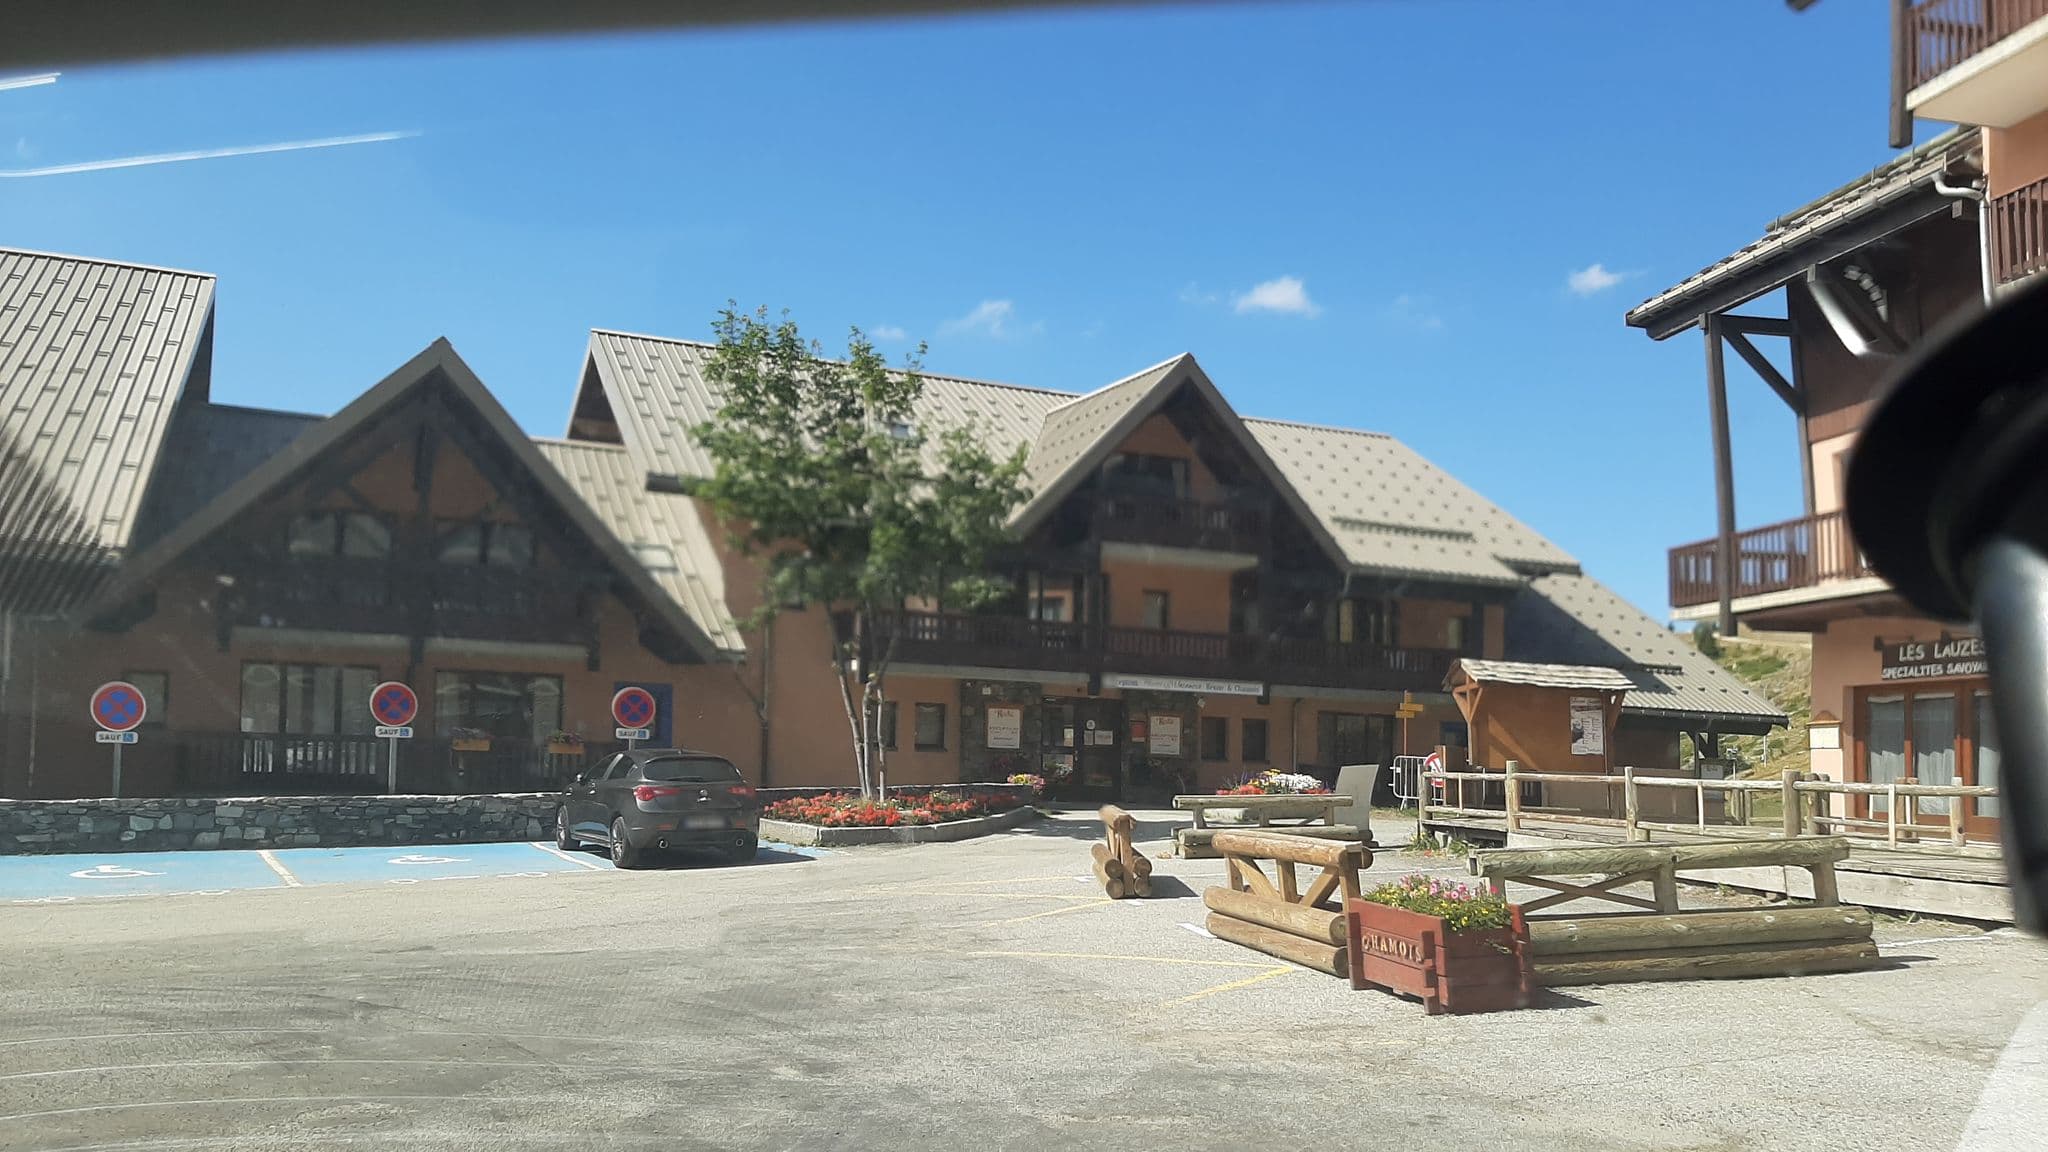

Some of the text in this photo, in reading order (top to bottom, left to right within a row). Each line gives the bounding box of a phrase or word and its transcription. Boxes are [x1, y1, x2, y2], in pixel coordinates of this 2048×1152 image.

[1899, 643, 1925, 662] LES
[98, 733, 121, 741] SAUF
[1361, 934, 1423, 963] CHAMOIS
